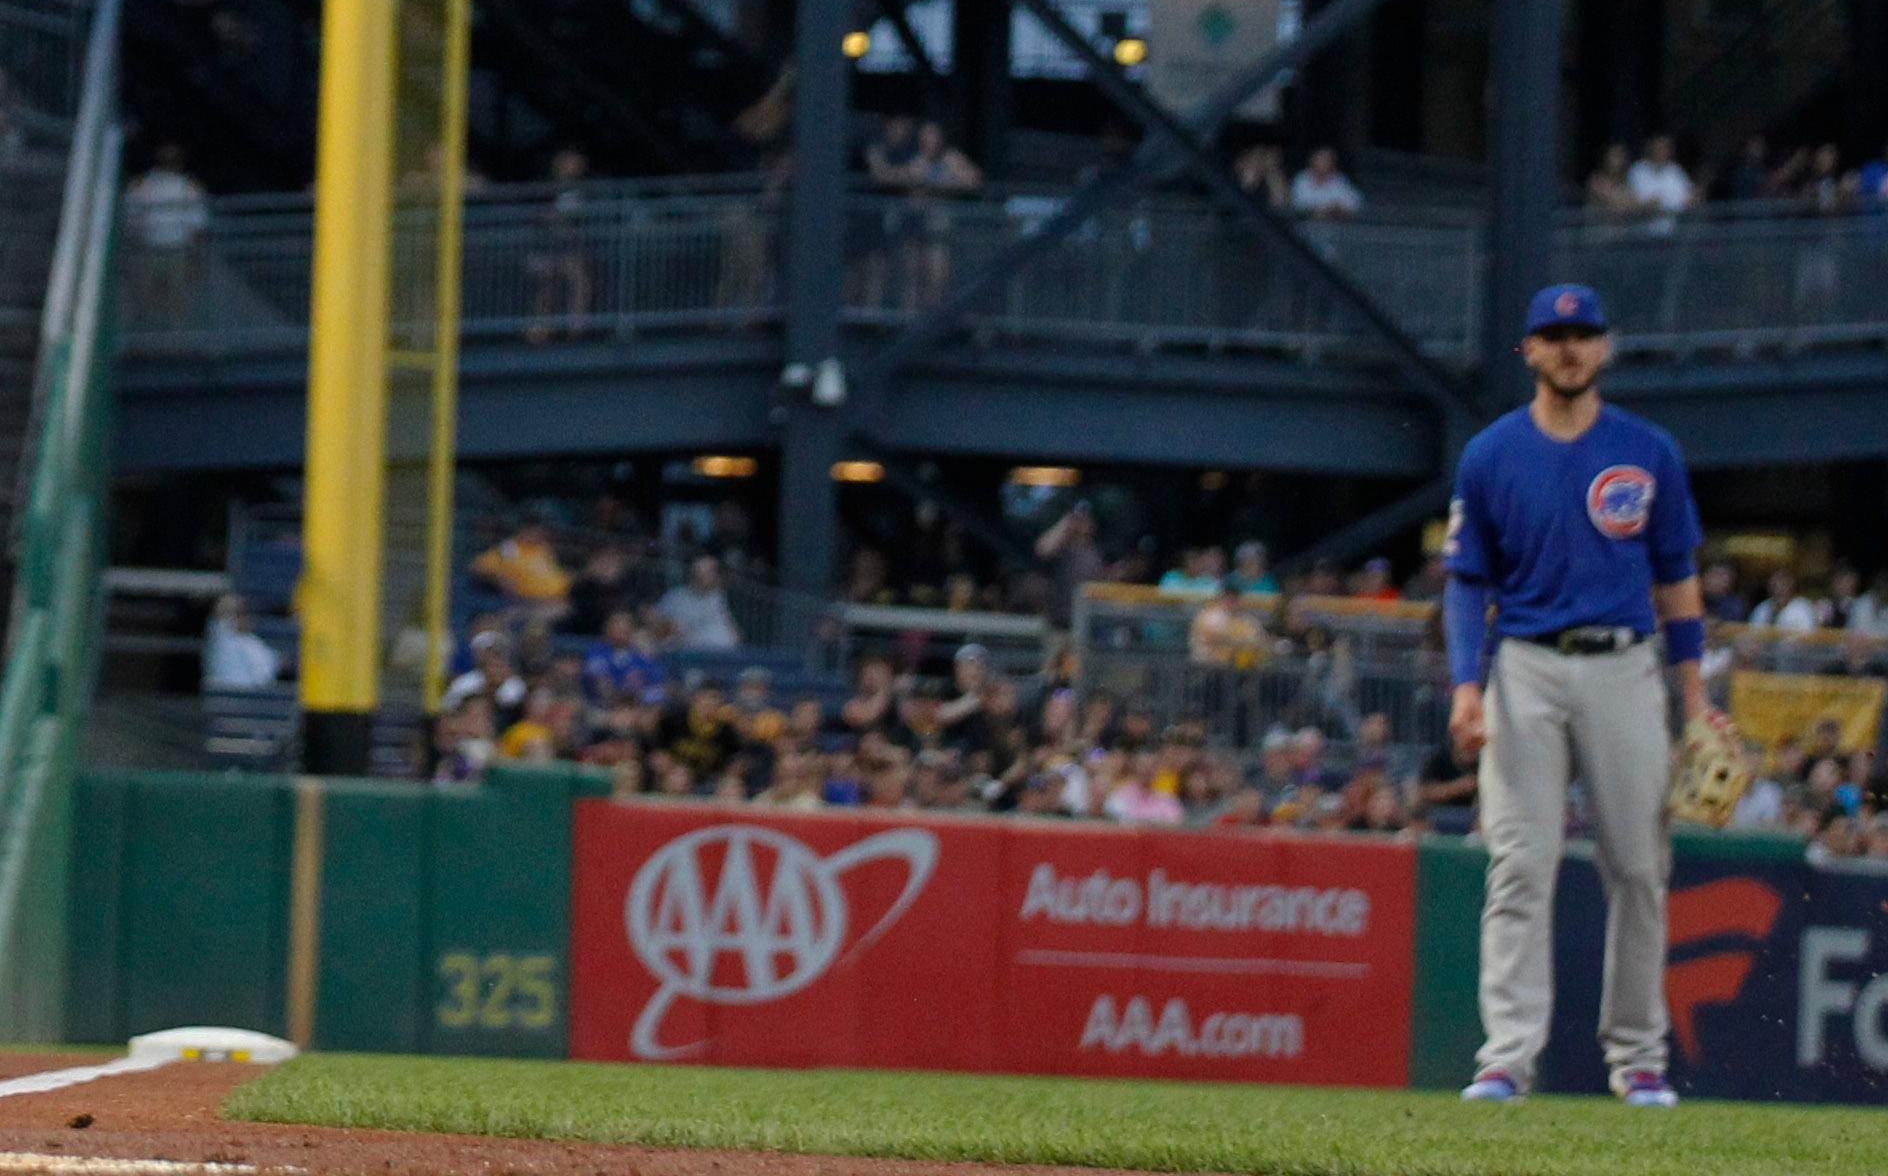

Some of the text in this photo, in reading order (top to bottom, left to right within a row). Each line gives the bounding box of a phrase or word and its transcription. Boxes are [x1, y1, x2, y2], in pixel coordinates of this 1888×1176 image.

[643, 827, 827, 998] AAA
[1018, 862, 1369, 936] Auto Insurance
[441, 955, 556, 1027] 325
[1079, 993, 1305, 1058] AAA.com
